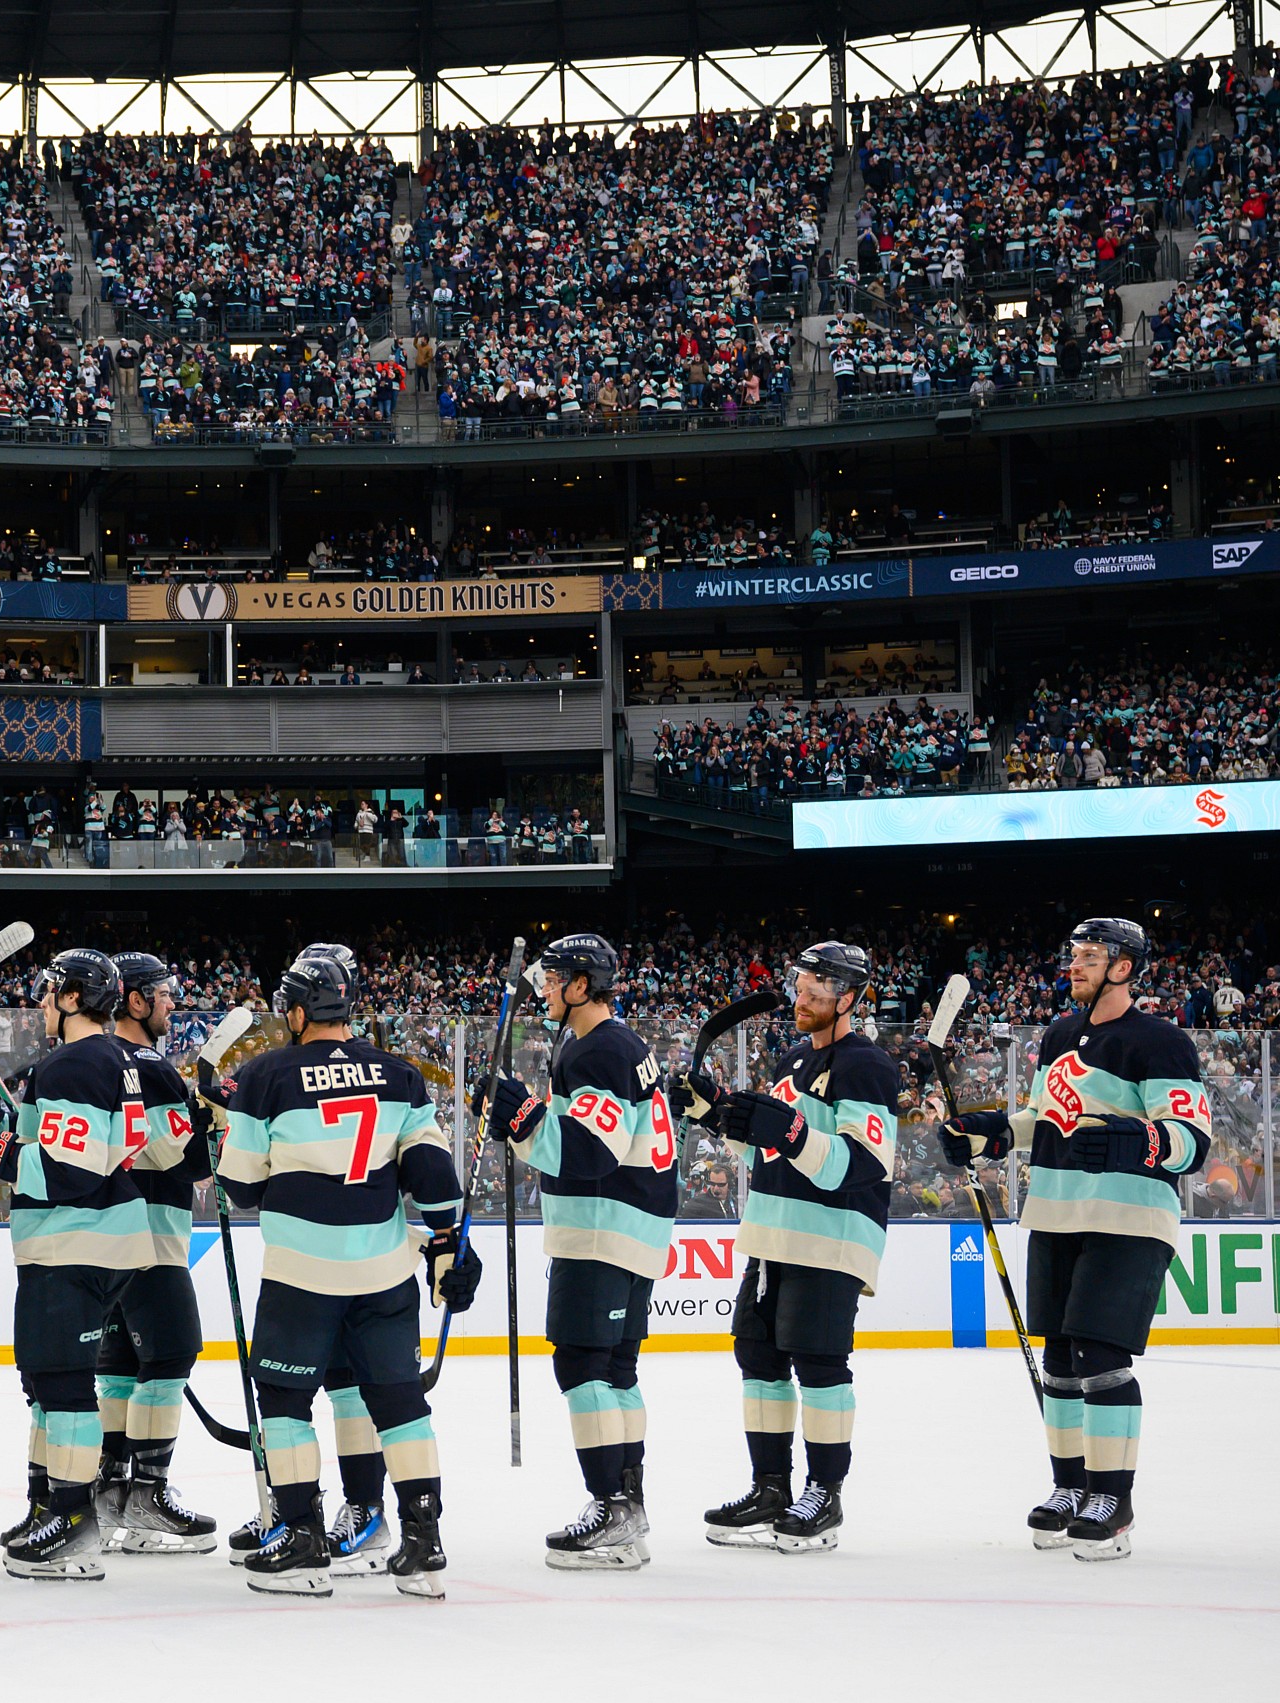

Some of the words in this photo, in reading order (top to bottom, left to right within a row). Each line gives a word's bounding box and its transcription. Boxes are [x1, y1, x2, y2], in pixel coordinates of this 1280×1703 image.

[1235, 8, 1247, 44] 334
[830, 61, 840, 96] 333
[29, 94, 37, 128] 331
[423, 90, 432, 124] 332
[1092, 556, 1117, 565] NAVY
[1118, 554, 1155, 564] FEDERAL
[1093, 565, 1125, 574] CREDIT
[1126, 562, 1156, 572] UNION
[1213, 546, 1251, 564] SAP
[695, 572, 873, 598] #WINTERCLASSIC
[949, 564, 1019, 582] GEICO
[264, 592, 346, 609] VEGAS
[351, 584, 445, 614] GOLDEN
[451, 580, 556, 613] KNIGHTS
[563, 938, 598, 949] KRAKEN
[337, 984, 346, 998] 7
[300, 1063, 387, 1092] EBERLE
[809, 1069, 831, 1097] A
[570, 1092, 623, 1134] 95
[1168, 1089, 1212, 1124] 24
[38, 1111, 90, 1154] 52
[167, 1108, 195, 1138] 4
[865, 1113, 884, 1146] 6
[316, 1093, 381, 1185] 7
[951, 1252, 984, 1262] adidas
[647, 1300, 709, 1316] ower
[259, 1358, 317, 1376] BAUER
[40, 1538, 67, 1556] BAUER
